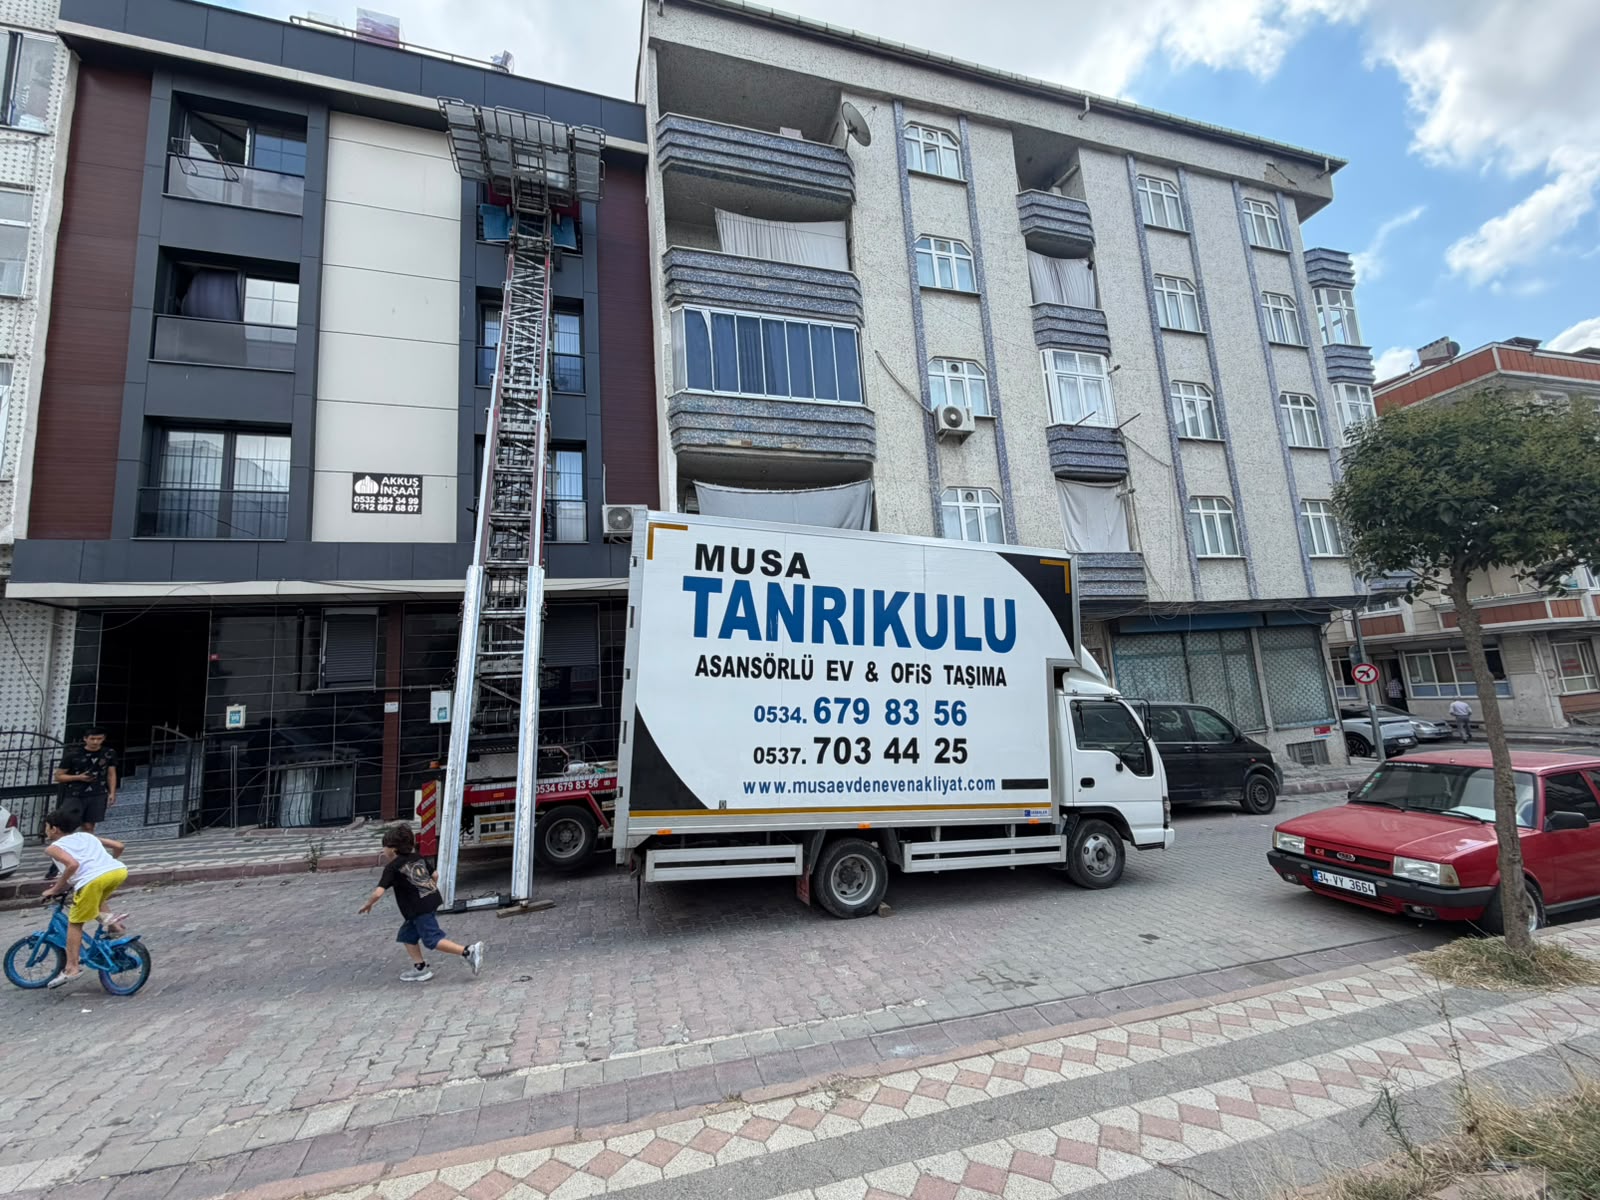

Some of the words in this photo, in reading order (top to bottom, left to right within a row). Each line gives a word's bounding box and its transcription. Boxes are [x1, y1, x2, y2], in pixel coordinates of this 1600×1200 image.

[382, 477, 419, 487] AKKUŞ
[695, 543, 811, 579] MUSA
[682, 576, 1016, 654] TANRIKULU
[695, 653, 814, 681] ASANSÖRLÜ
[826, 660, 854, 682] EV
[865, 661, 879, 683] &
[943, 664, 1007, 689] TAŞIMA
[753, 704, 808, 724] 0534.
[813, 697, 870, 725] 679
[884, 698, 920, 725] 83
[933, 700, 968, 726] 56
[753, 746, 807, 765] 0537.
[813, 737, 872, 765] 703
[883, 737, 920, 764] 44
[934, 738, 968, 764] 25
[557, 782, 573, 792] 679
[575, 780, 586, 790] 83
[588, 778, 599, 788] 56
[743, 776, 996, 795] www.musaevdenevenakliyat.com
[1317, 871, 1329, 883] 34
[1333, 875, 1344, 887] VY
[1349, 879, 1374, 895] 3664
